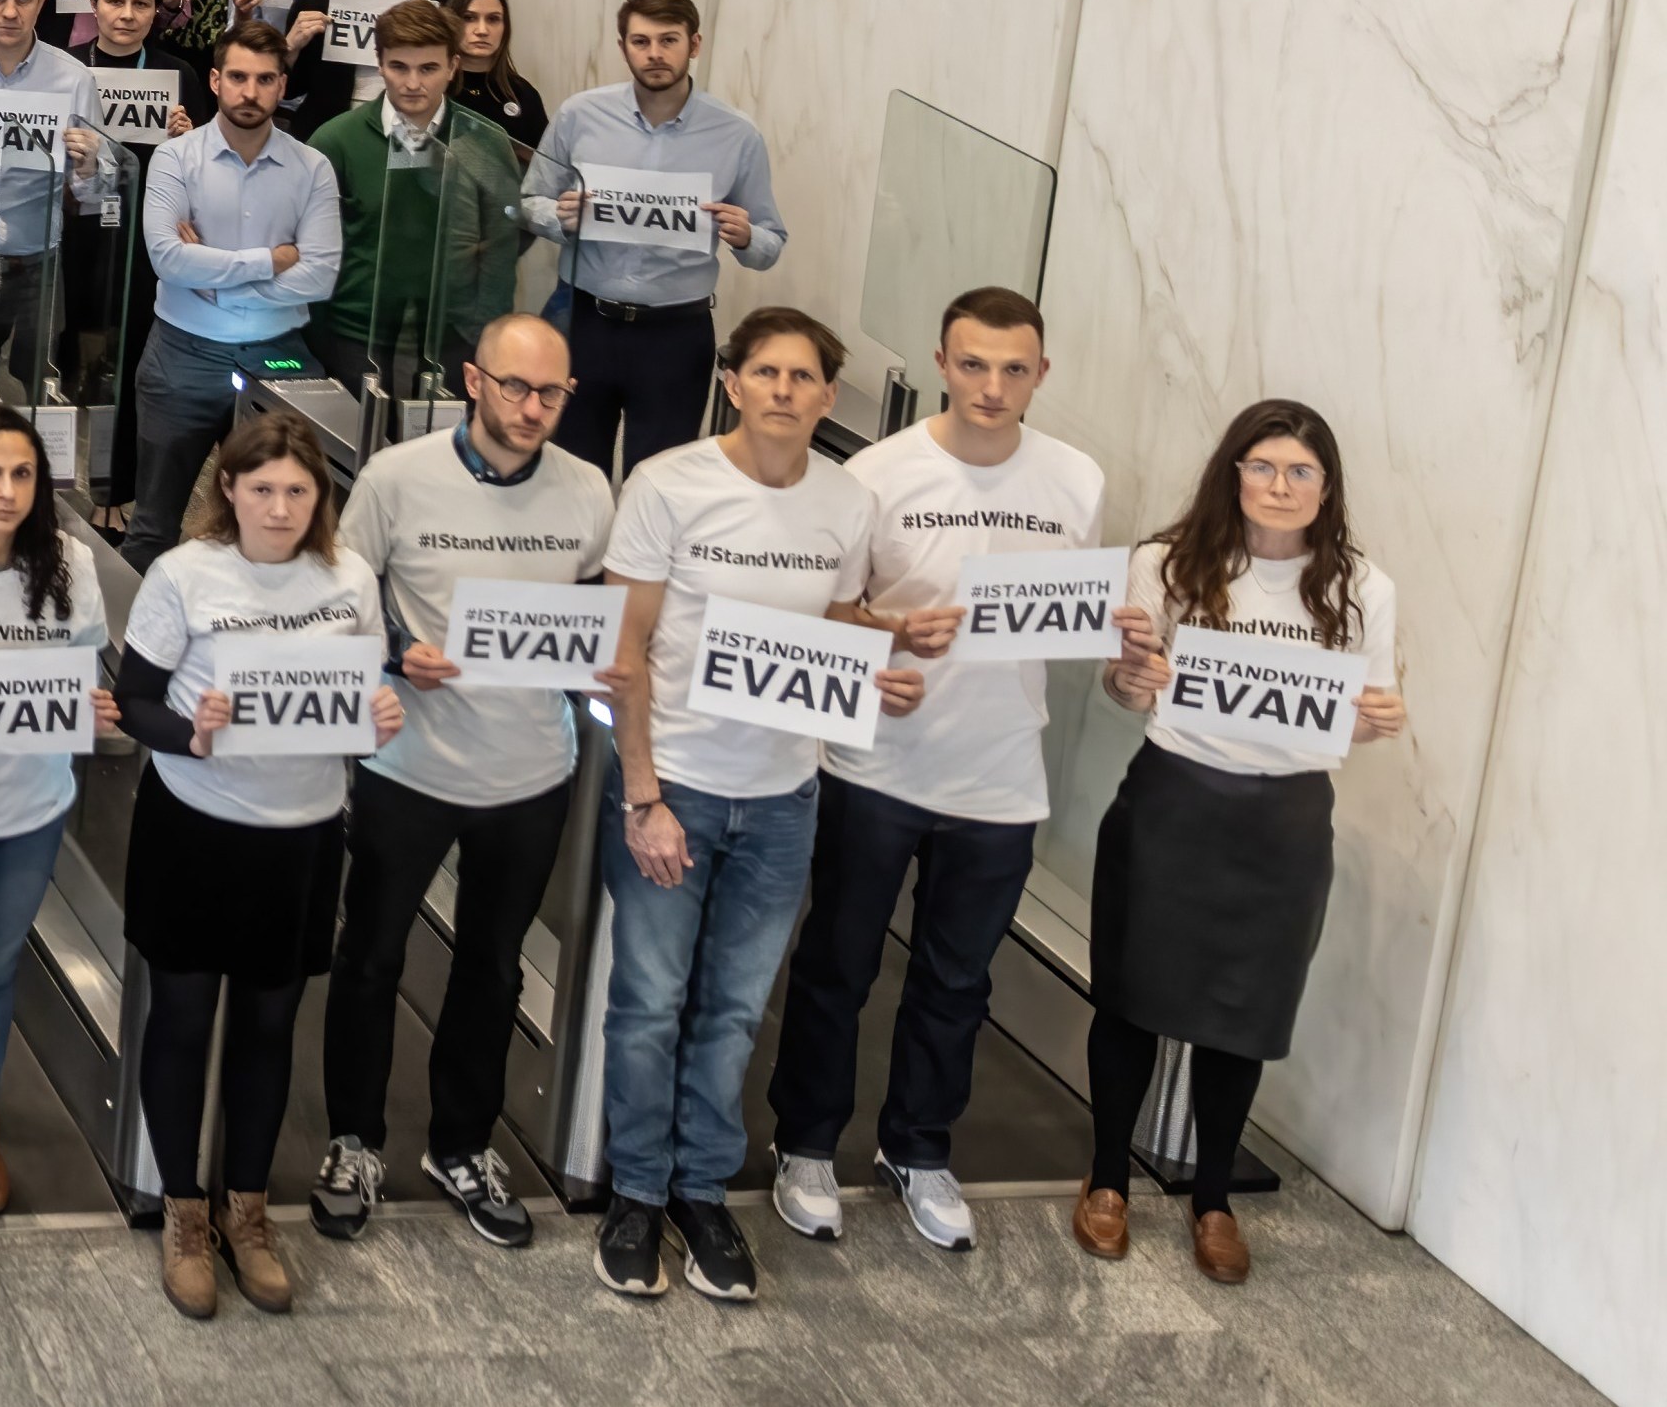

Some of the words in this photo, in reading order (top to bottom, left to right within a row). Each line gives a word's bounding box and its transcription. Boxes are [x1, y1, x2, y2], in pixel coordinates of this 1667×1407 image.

[589, 190, 698, 207] #ISTANDWITH
[593, 203, 696, 233] EVAN
[971, 580, 1110, 598] #ISTANDWITH
[465, 609, 605, 628] #ISTANDWITH
[970, 600, 1106, 634] EVAN
[464, 627, 599, 664] EVAN
[707, 630, 869, 676] #ISTANDWITH
[230, 670, 364, 686] #ISTANDWITH
[703, 650, 861, 719] EVAN
[1175, 654, 1344, 694] #ISTANDWITH
[231, 691, 361, 725] EVAN
[1172, 672, 1337, 732] EVAN
